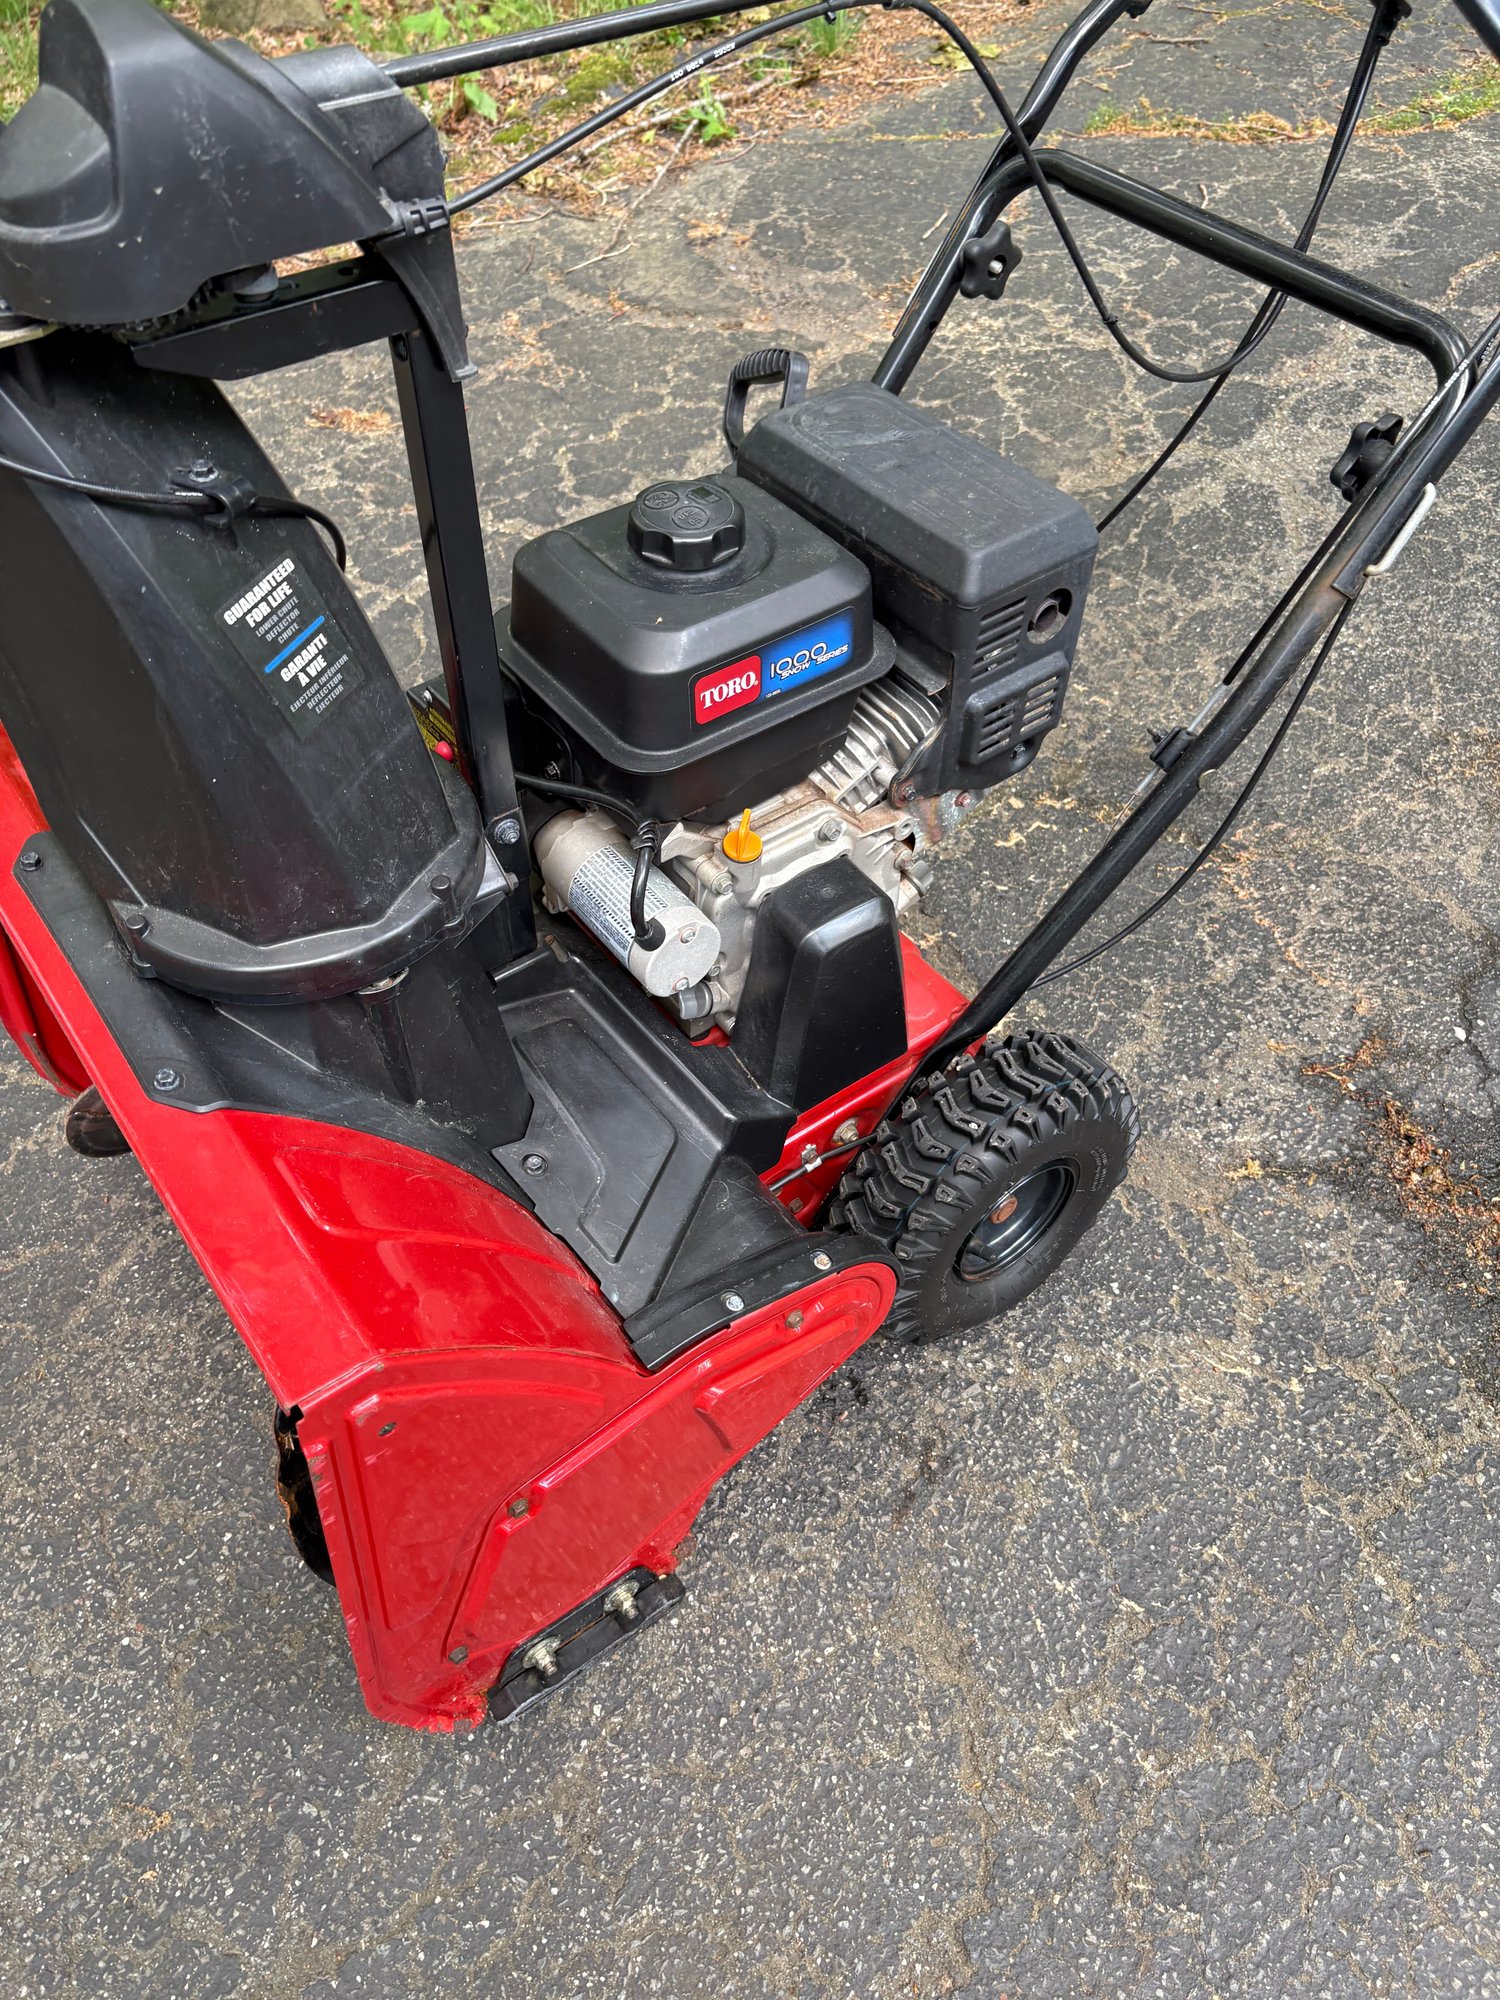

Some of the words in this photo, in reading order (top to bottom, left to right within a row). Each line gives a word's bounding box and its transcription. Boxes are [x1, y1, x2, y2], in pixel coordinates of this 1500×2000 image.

[223, 558, 296, 626] GUARANTEED
[245, 601, 272, 628] FOR
[266, 581, 293, 609] LIFE
[255, 614, 279, 638] LOWER
[277, 595, 300, 618] CHUTE
[265, 608, 301, 642] DEFLECTOR
[277, 621, 301, 645] CHUTE
[280, 632, 329, 683] GARANTI
[305, 654, 328, 678] VIE
[770, 642, 827, 679] 1000
[780, 661, 811, 680] SNOW
[816, 644, 849, 665] SERIES
[700, 671, 757, 709] TORO
